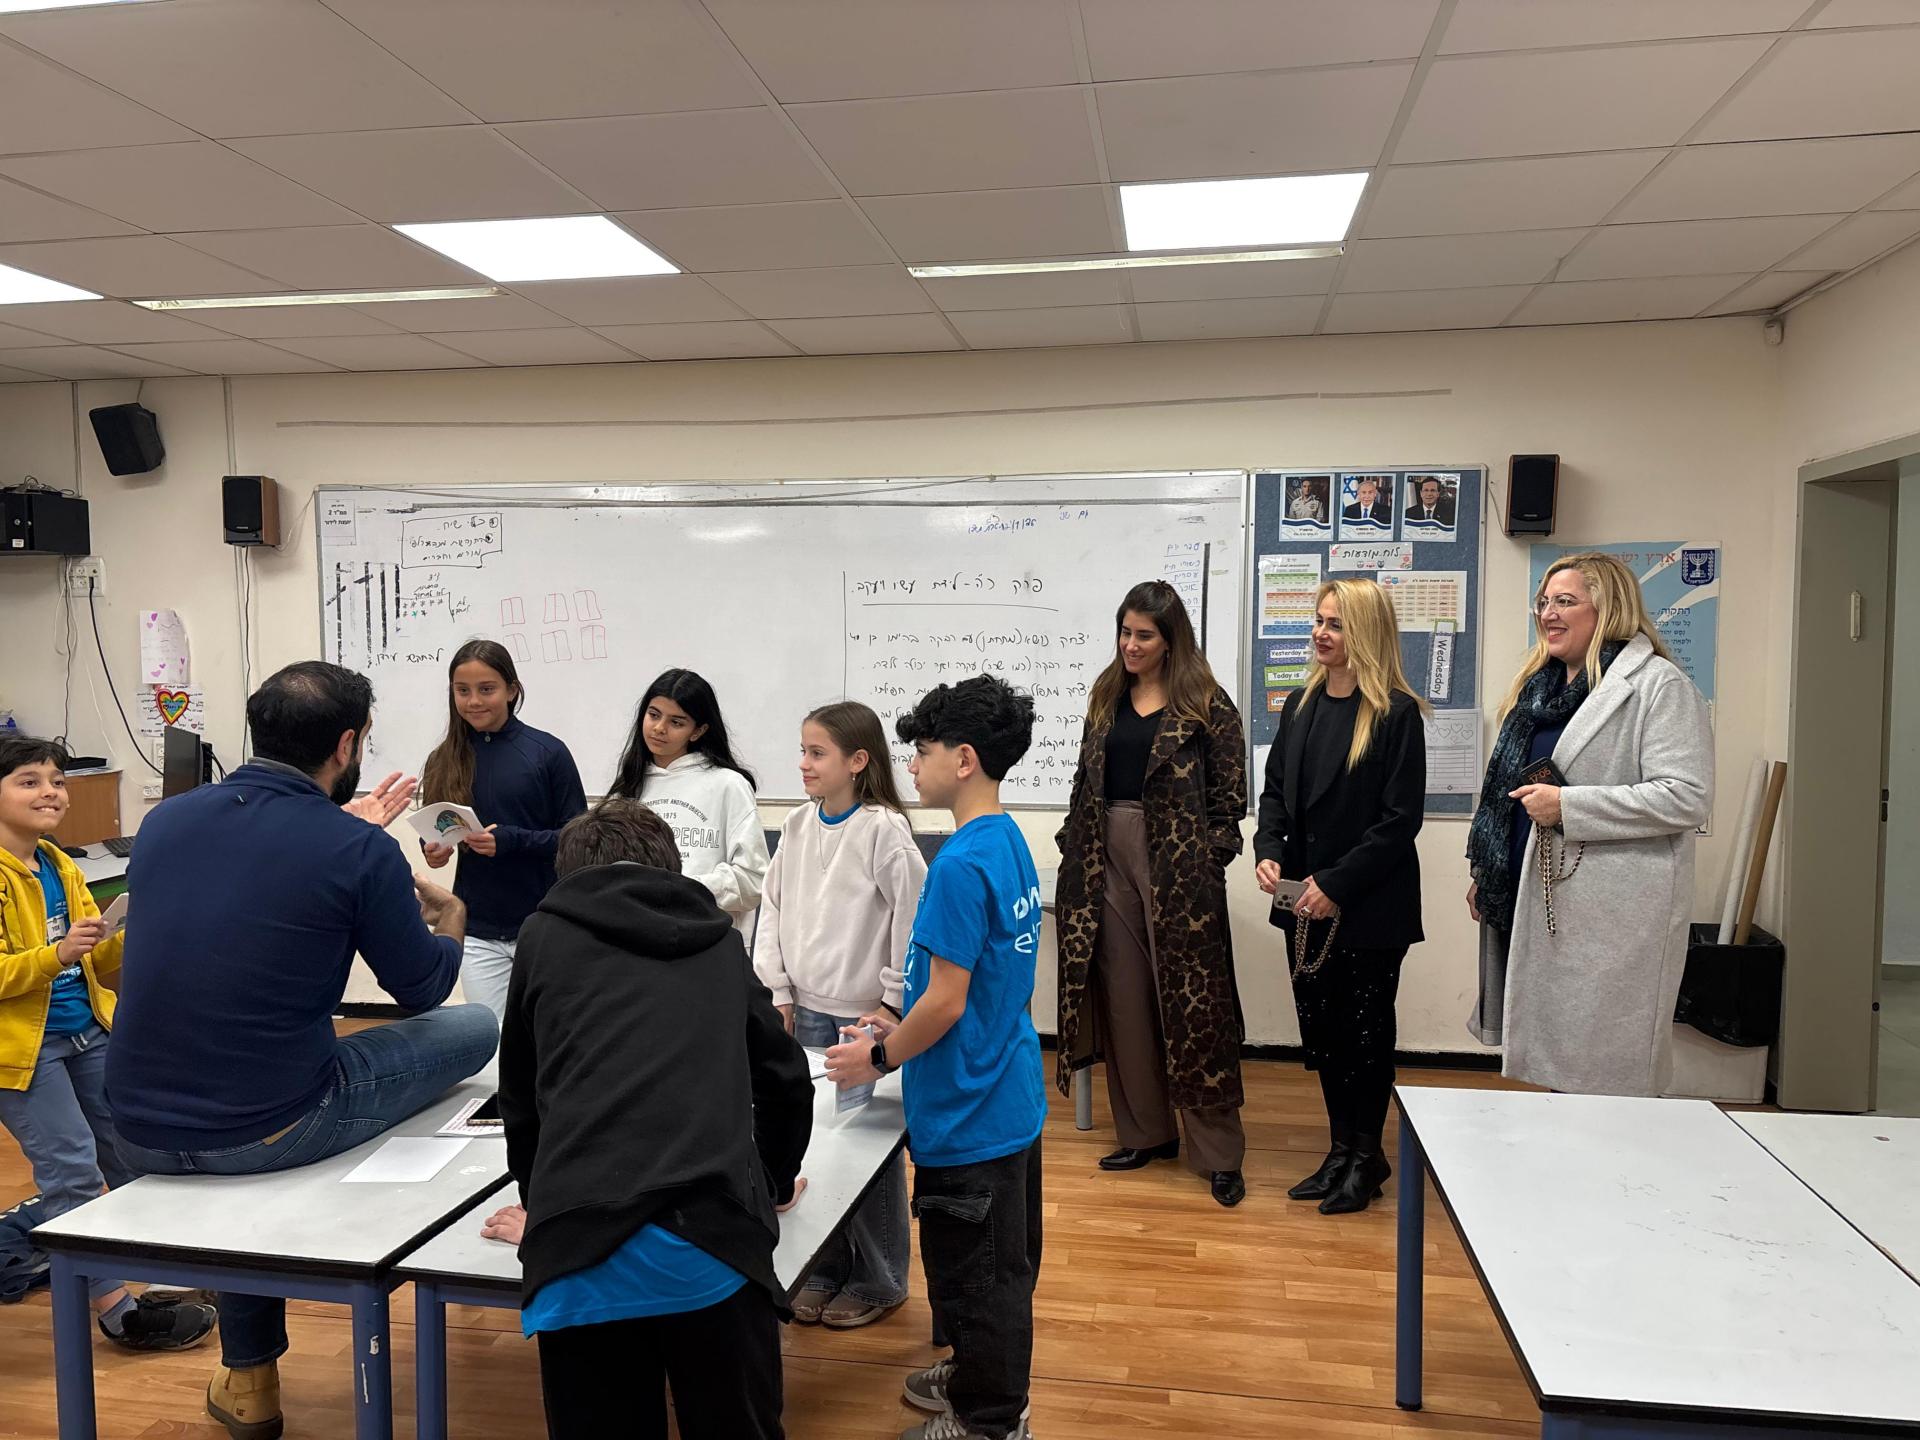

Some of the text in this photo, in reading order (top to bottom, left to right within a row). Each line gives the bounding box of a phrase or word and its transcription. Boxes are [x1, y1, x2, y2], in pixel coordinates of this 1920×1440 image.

[1342, 546, 1401, 560] לוח מודעות
[1012, 577, 1043, 595] פרק
[1273, 671, 1293, 681] Today
[1431, 639, 1448, 695] Wednesday
[670, 798, 690, 809] ANOTHER
[688, 804, 709, 823] OBJECTIVE
[671, 826, 720, 848] PECIAL
